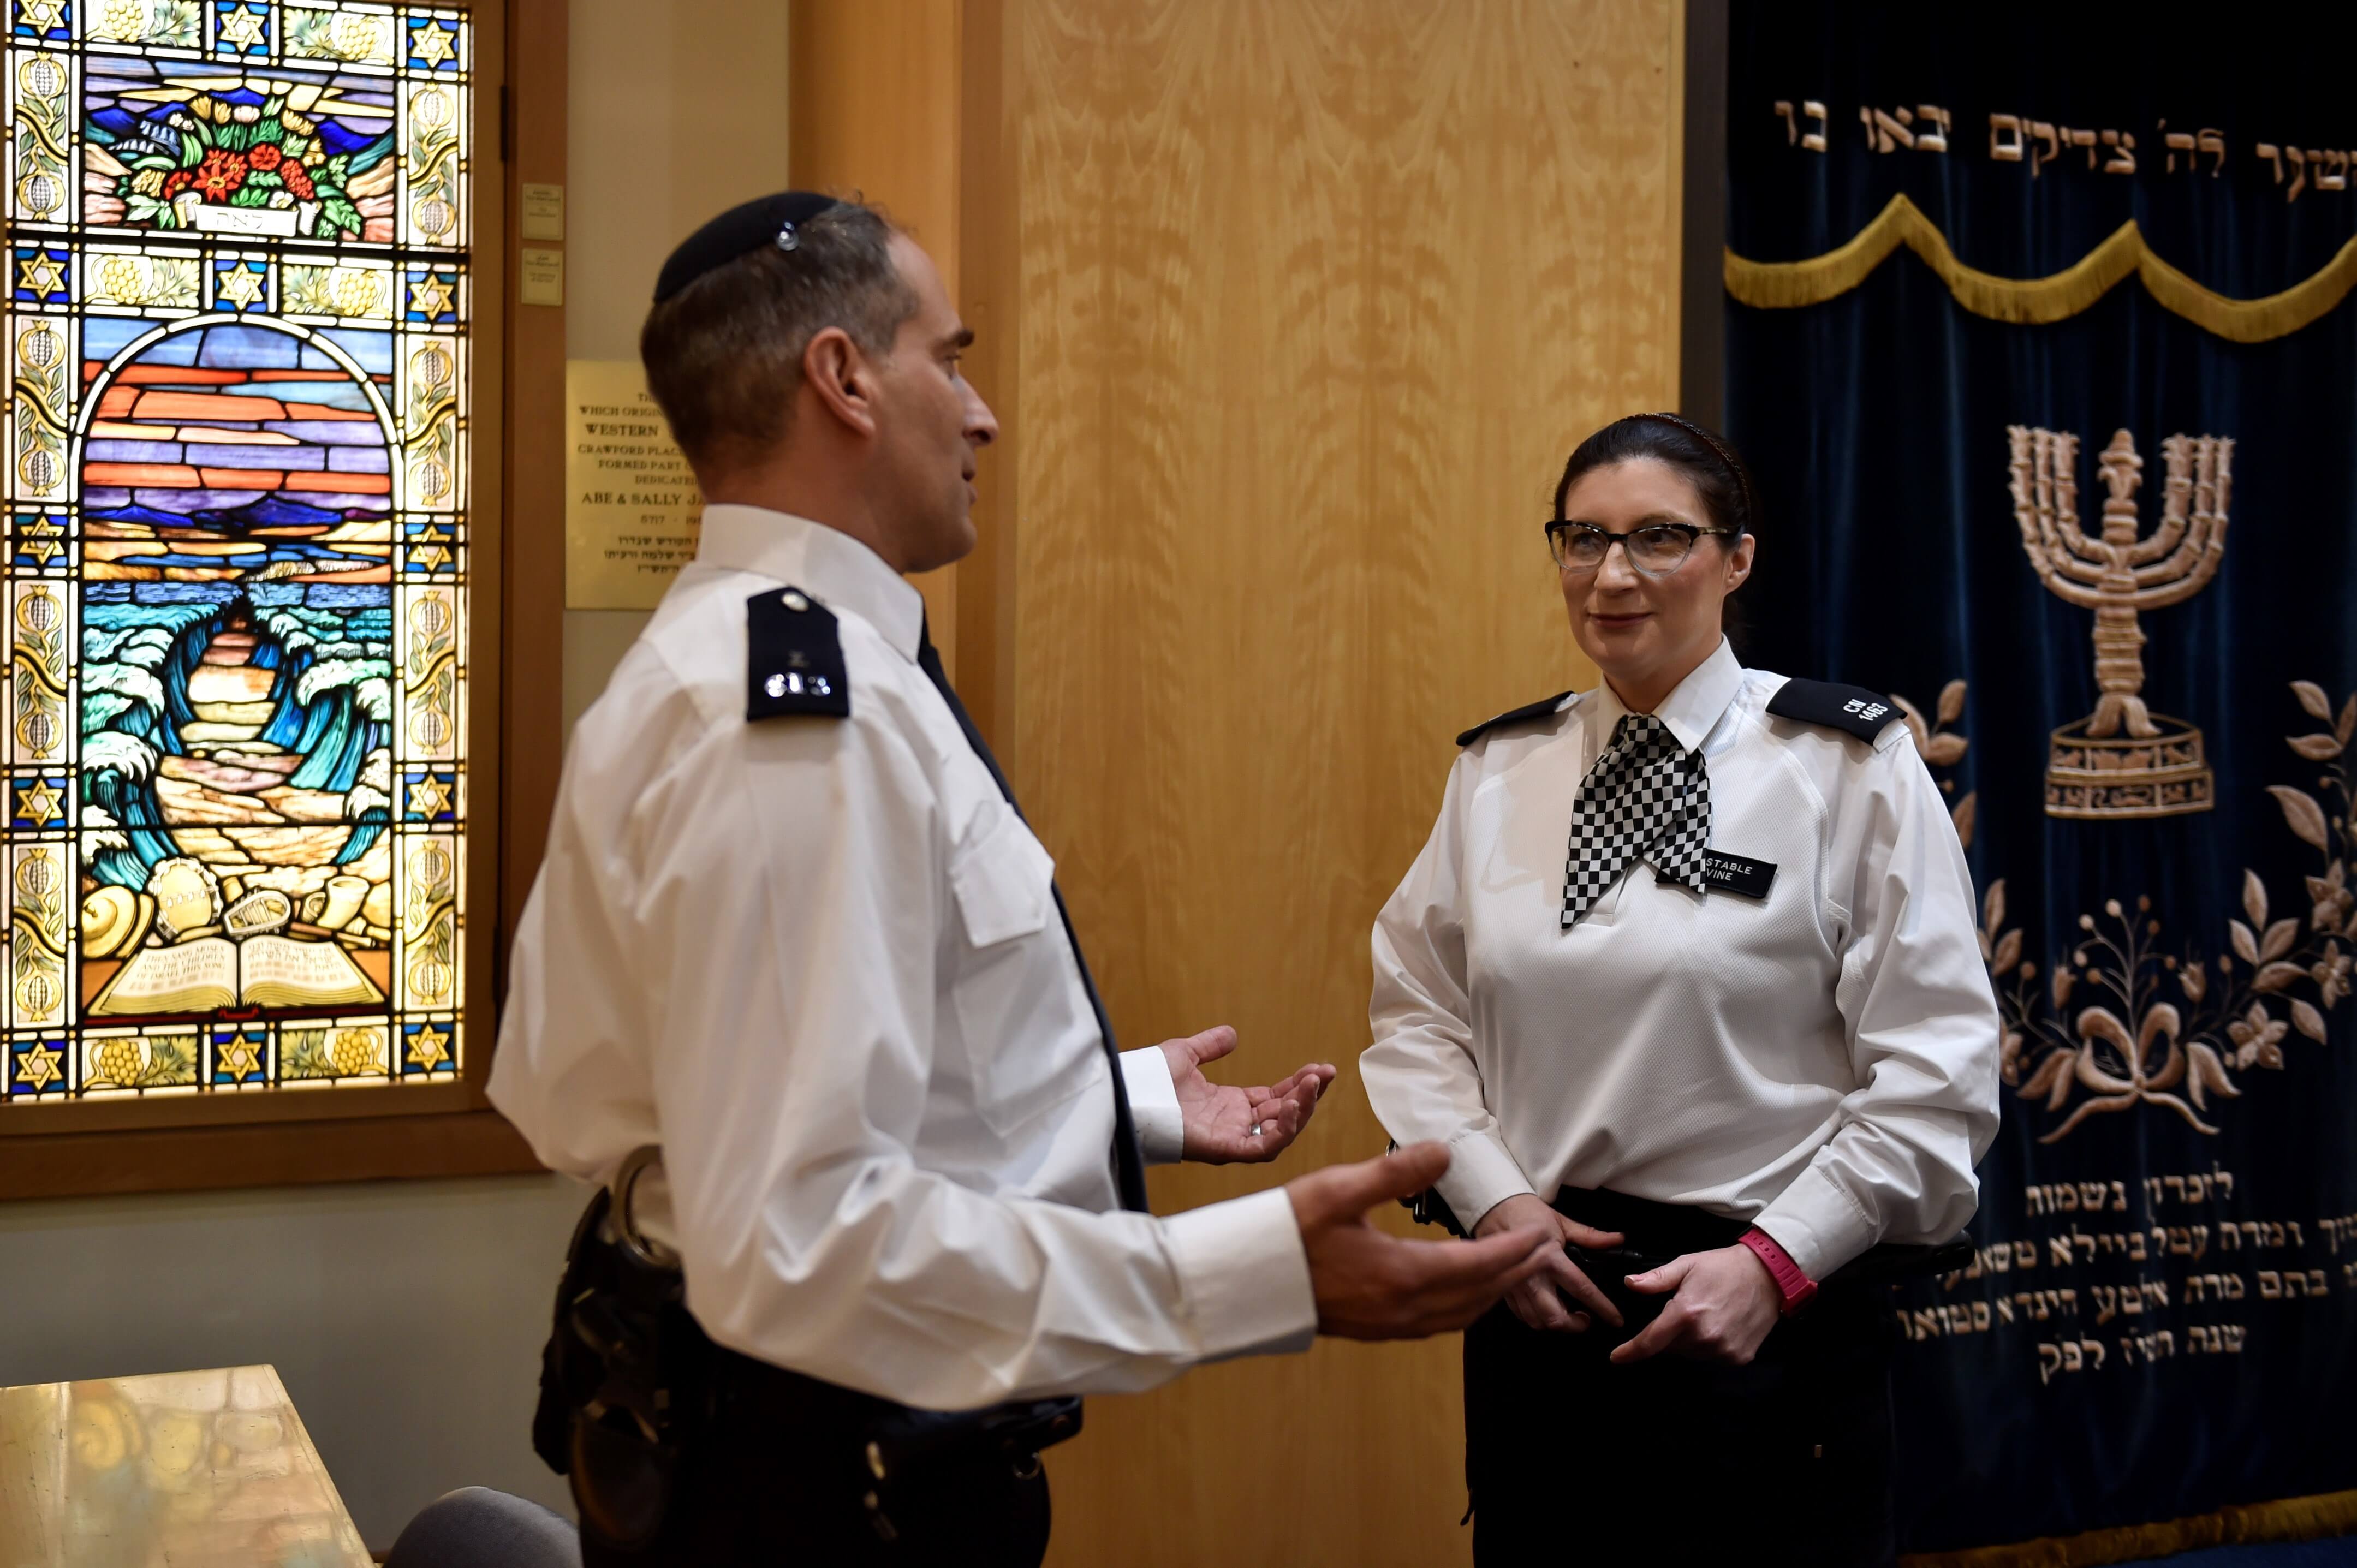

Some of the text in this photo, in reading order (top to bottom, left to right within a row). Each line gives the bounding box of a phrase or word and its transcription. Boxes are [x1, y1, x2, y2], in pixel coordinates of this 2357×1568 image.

[1774, 99, 1829, 153] בו
[1859, 104, 1951, 153] יבאו
[1990, 112, 2136, 178] צדיקים
[2255, 143, 2357, 204] שער
[217, 212, 263, 229] לאה
[579, 405, 663, 416] WHICH ORIGIN
[585, 422, 658, 436] WESTERN
[578, 444, 645, 455] CRAWFORD
[598, 458, 647, 470] FORMED
[651, 461, 681, 471] PART
[582, 491, 612, 504] ABE
[617, 493, 627, 505] &
[632, 493, 681, 505] SALLY
[1843, 699, 1867, 713] CN
[1859, 702, 1888, 721] 1463
[1706, 858, 1753, 875] STABLE
[2026, 1179, 2127, 1218] נשמות
[2257, 1268, 2330, 1299] בתם
